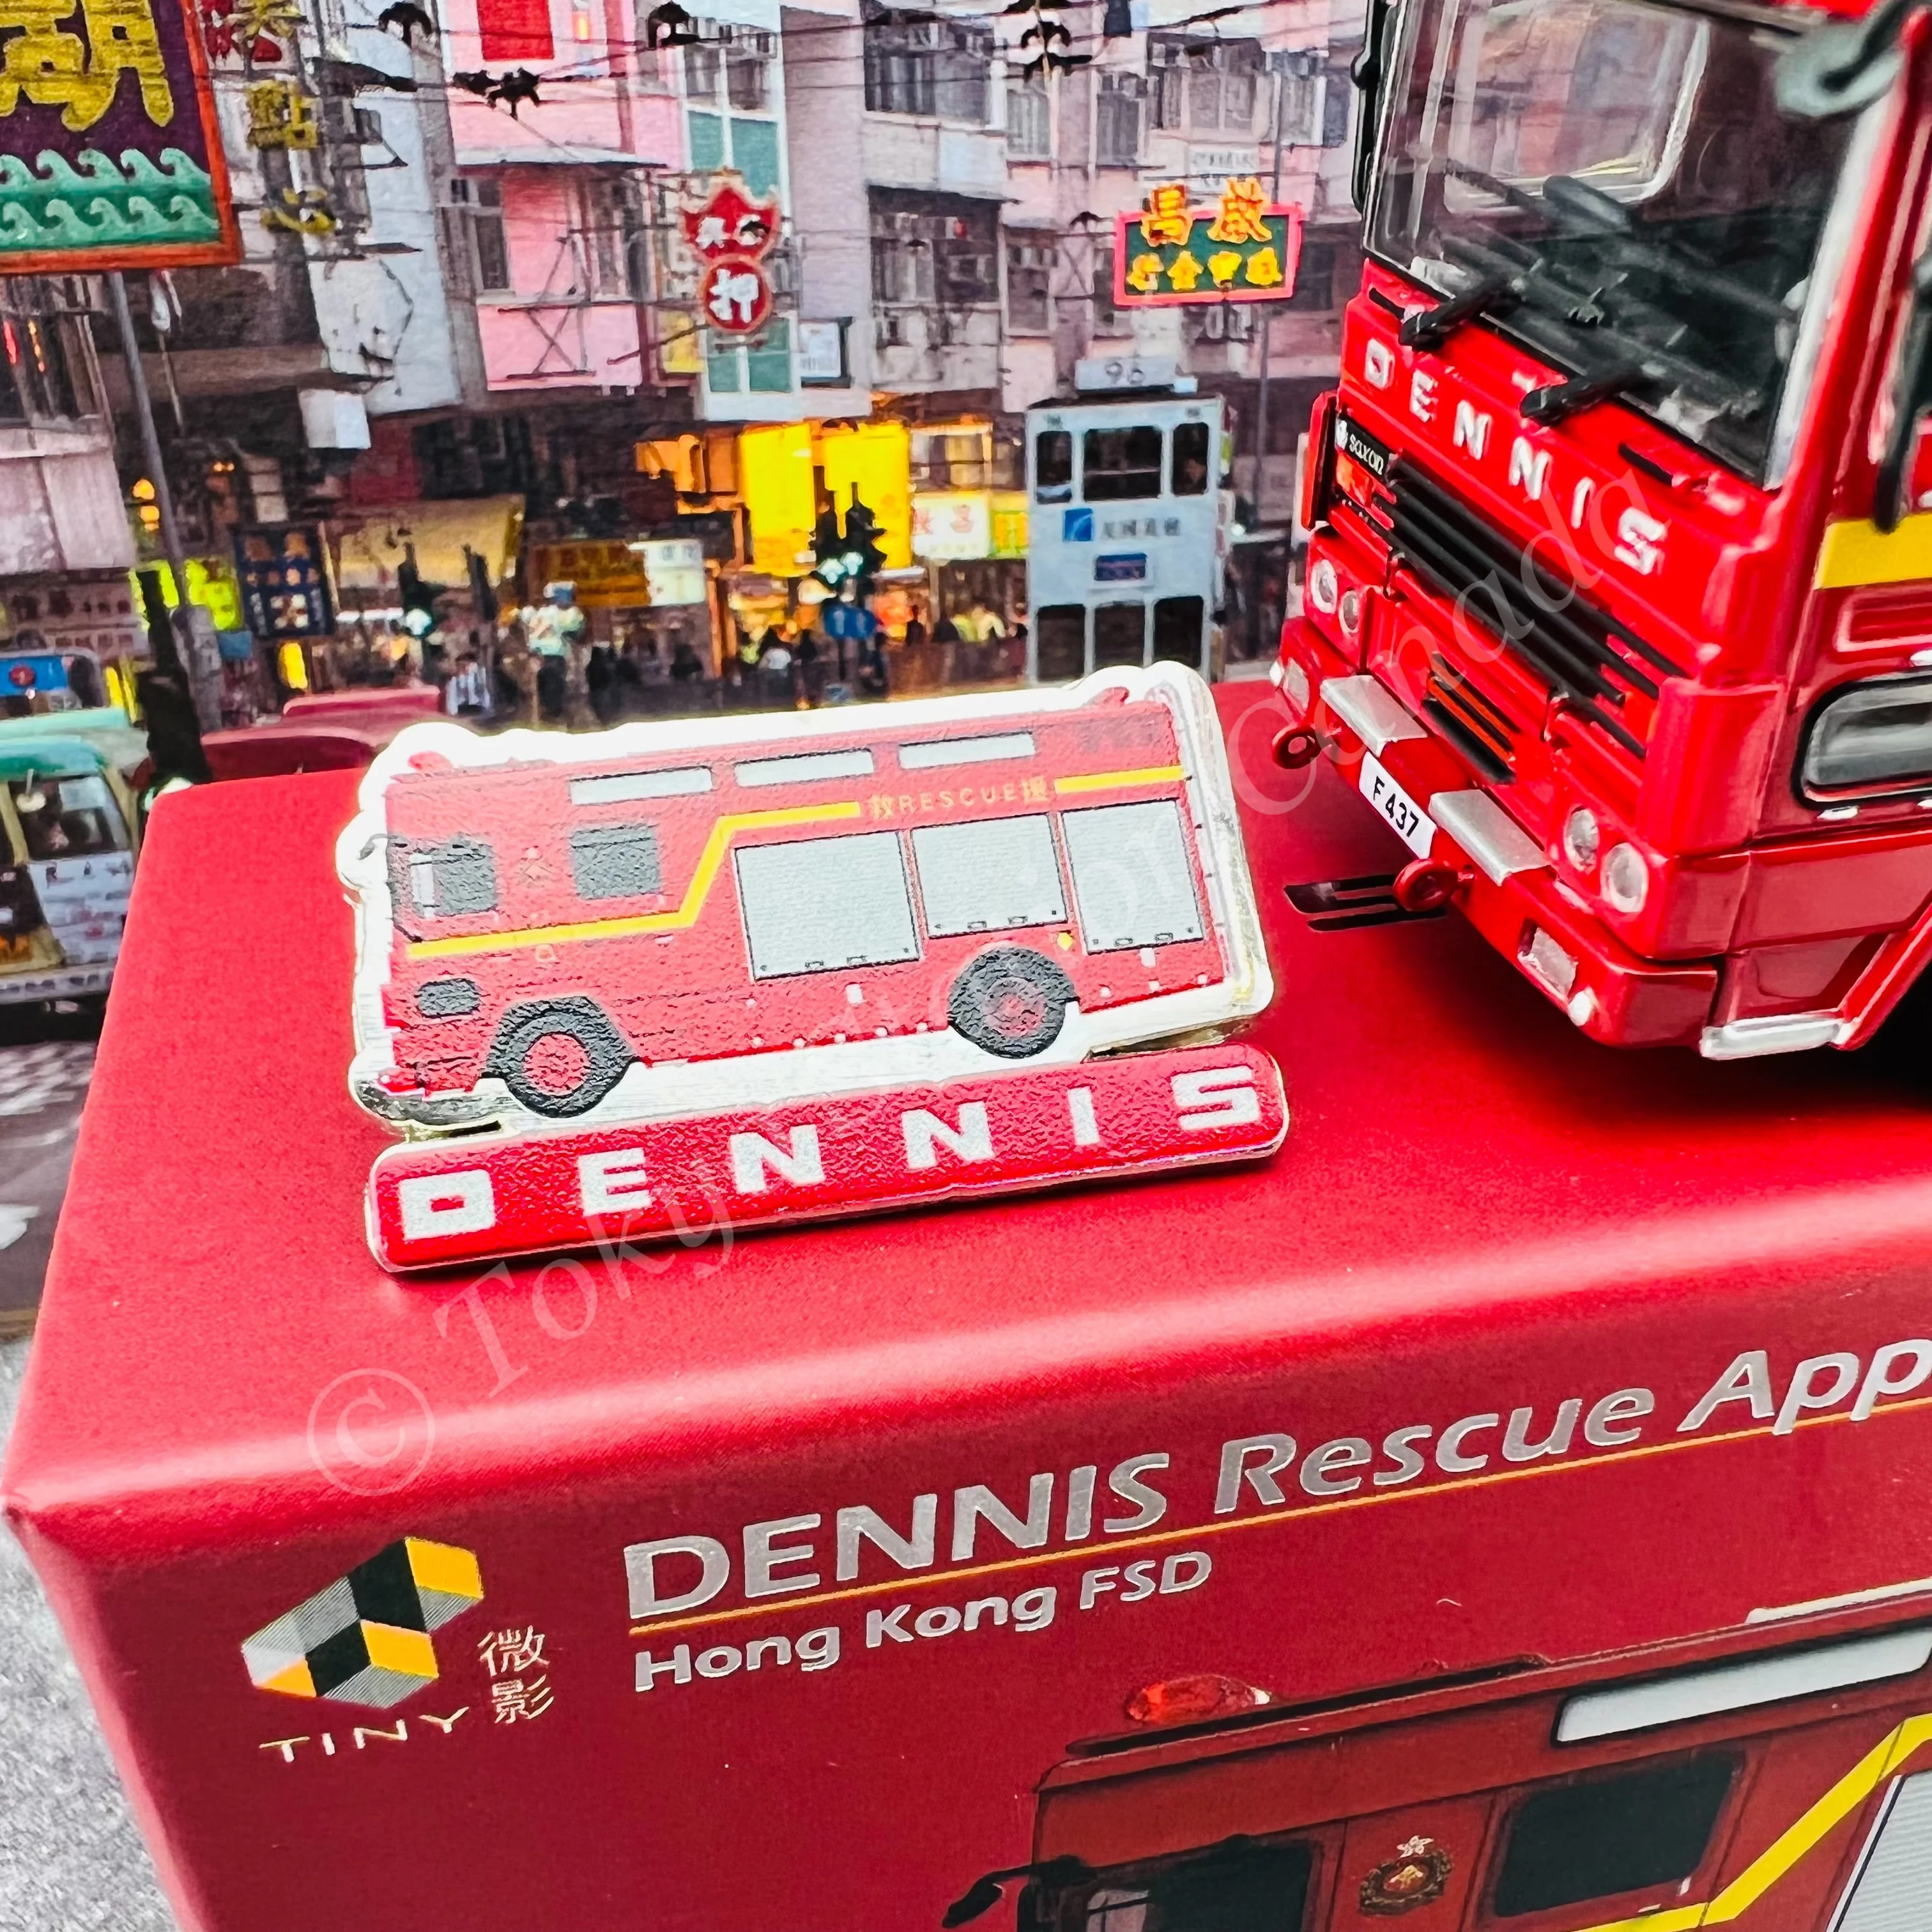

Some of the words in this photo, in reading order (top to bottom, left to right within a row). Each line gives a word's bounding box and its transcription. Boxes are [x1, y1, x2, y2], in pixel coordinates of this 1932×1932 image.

[898, 782, 1017, 813] RESCUE
[623, 1452, 1170, 1620] DENNIS
[1215, 1387, 1655, 1514] Rescue
[1676, 1338, 1932, 1436] App
[635, 1626, 840, 1692] Hong
[865, 1586, 1057, 1649] Kong
[1078, 1551, 1212, 1610] FSD
[477, 1625, 555, 1724] 微影
[259, 1706, 470, 1764] TINY
